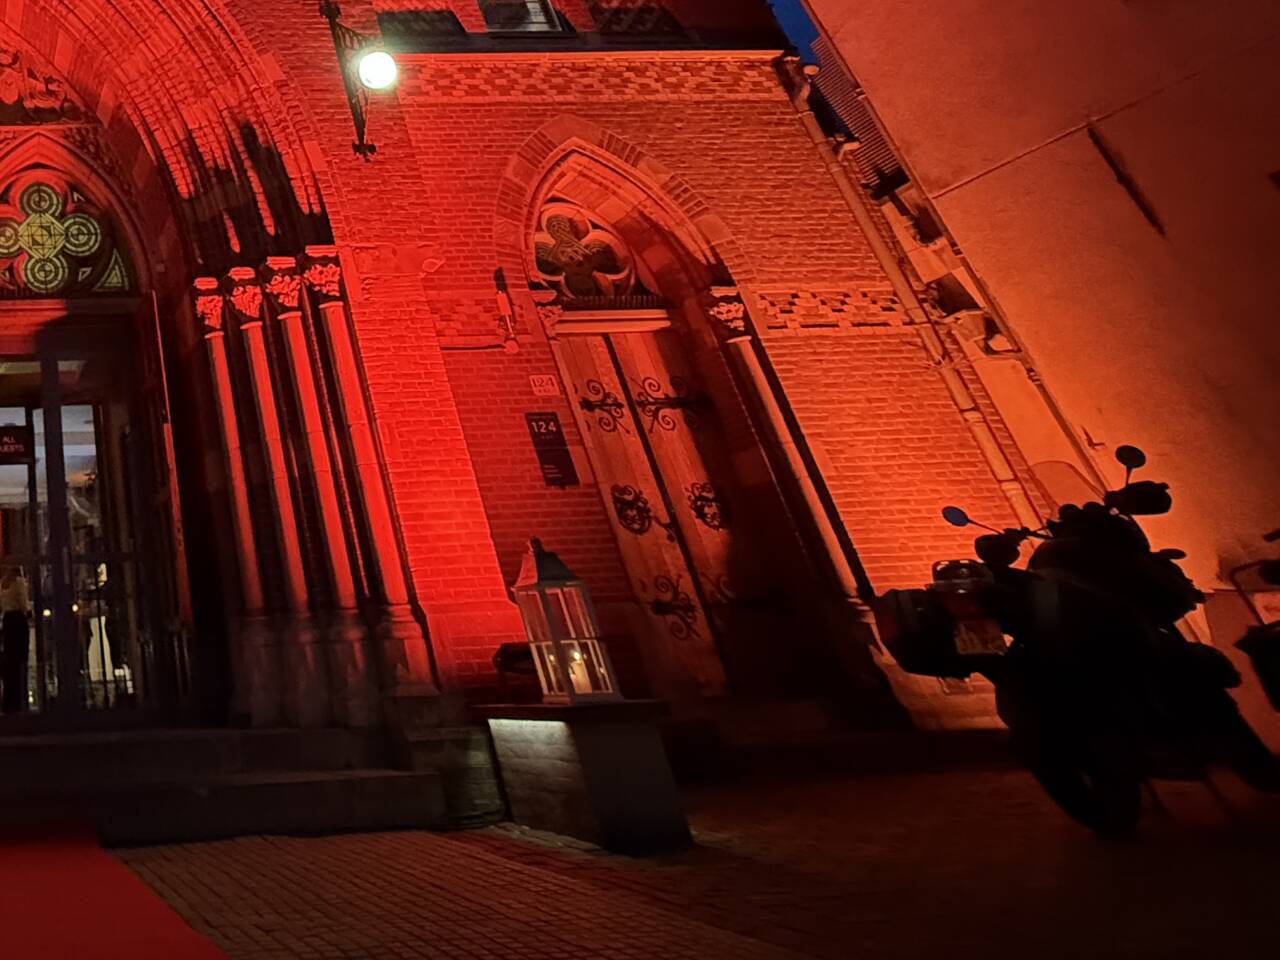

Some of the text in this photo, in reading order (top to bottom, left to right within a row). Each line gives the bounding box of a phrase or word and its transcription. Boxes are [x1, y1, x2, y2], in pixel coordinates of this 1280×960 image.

[532, 376, 555, 388] 124
[531, 421, 556, 433] 124
[2, 436, 16, 444] ALL
